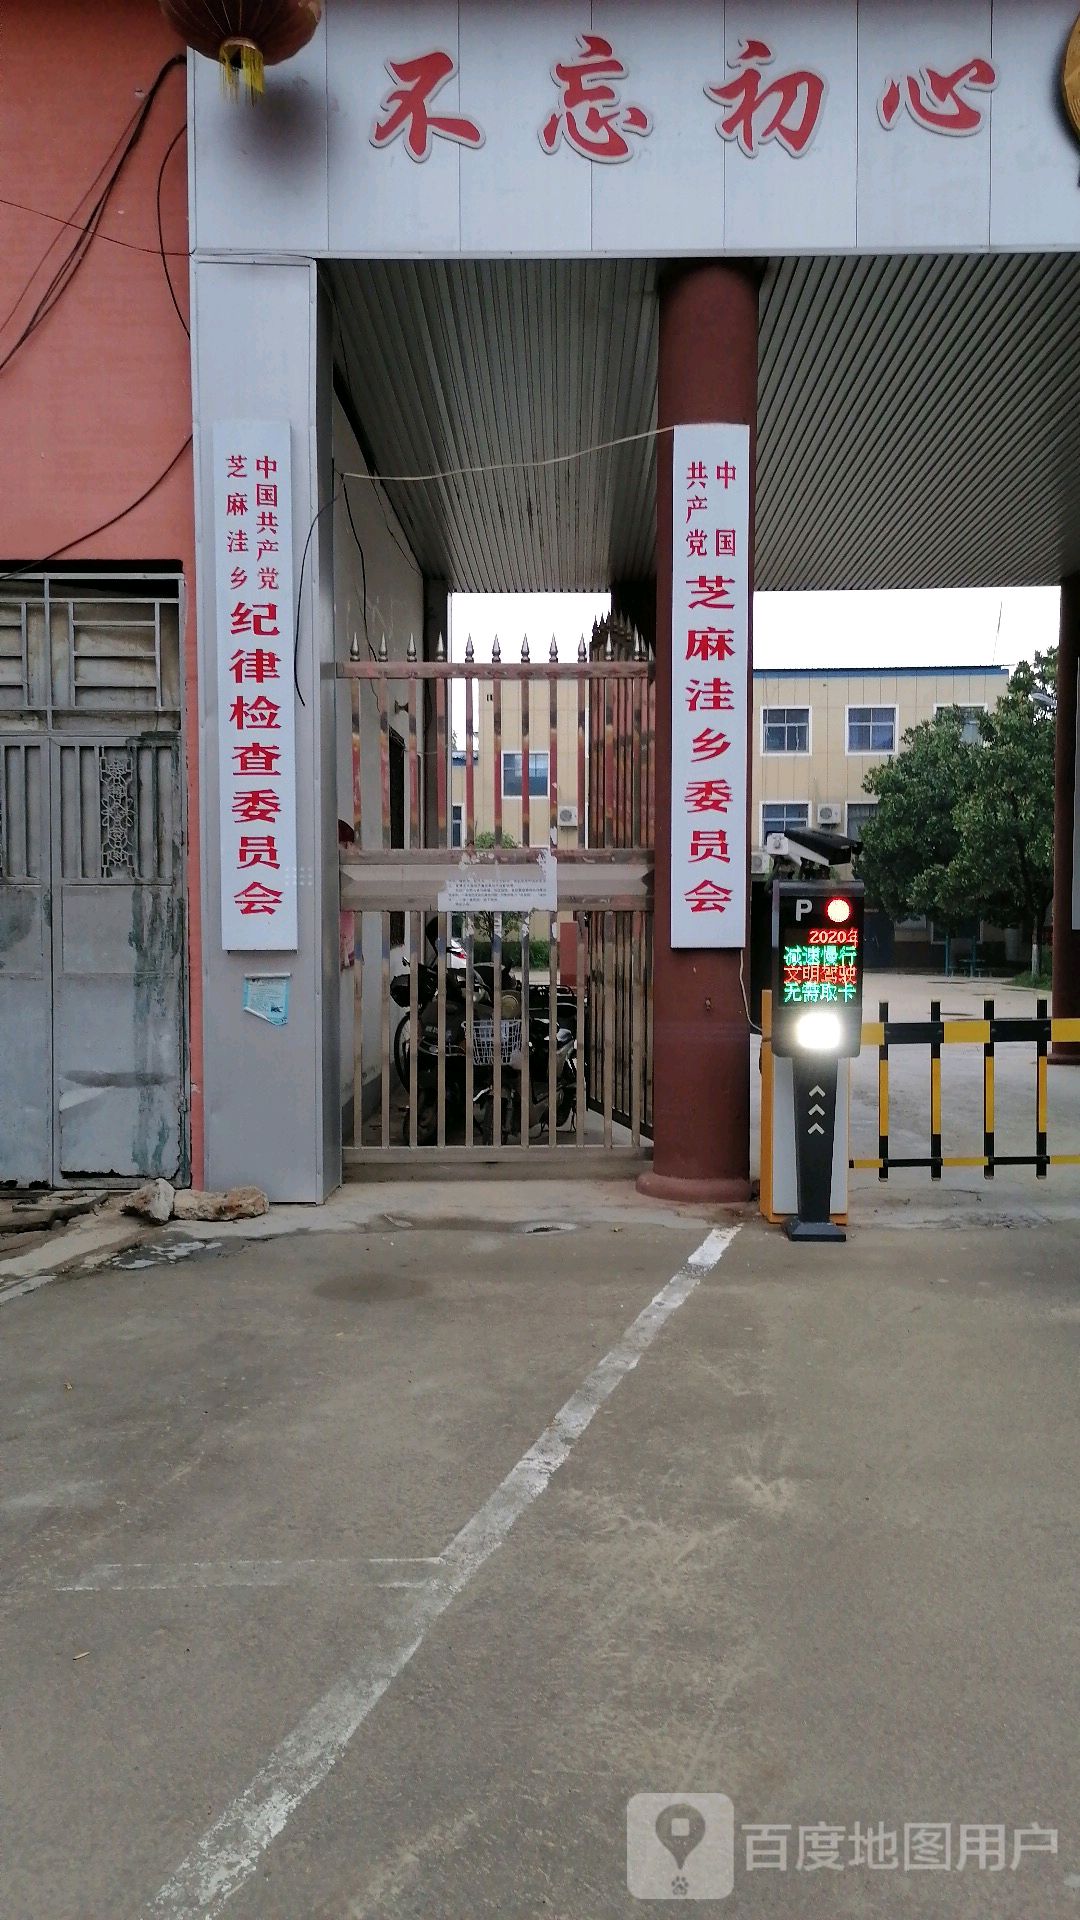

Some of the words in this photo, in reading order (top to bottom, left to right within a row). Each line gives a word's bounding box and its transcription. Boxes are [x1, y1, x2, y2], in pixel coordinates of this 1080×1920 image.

[369, 34, 998, 164] 不忘初心
[225, 454, 250, 591] 芝麻洼乡
[255, 455, 280, 591] 中国共产党
[685, 460, 709, 558] 共产党
[715, 460, 737, 557] 中国
[228, 601, 284, 916] 纪律检查委员会
[684, 575, 736, 913] 芝麻洼乡委员会
[783, 945, 858, 967] 减速慢行
[795, 899, 813, 922] P
[783, 965, 858, 984] 文明驾驶
[783, 982, 857, 1003] 无需取卡
